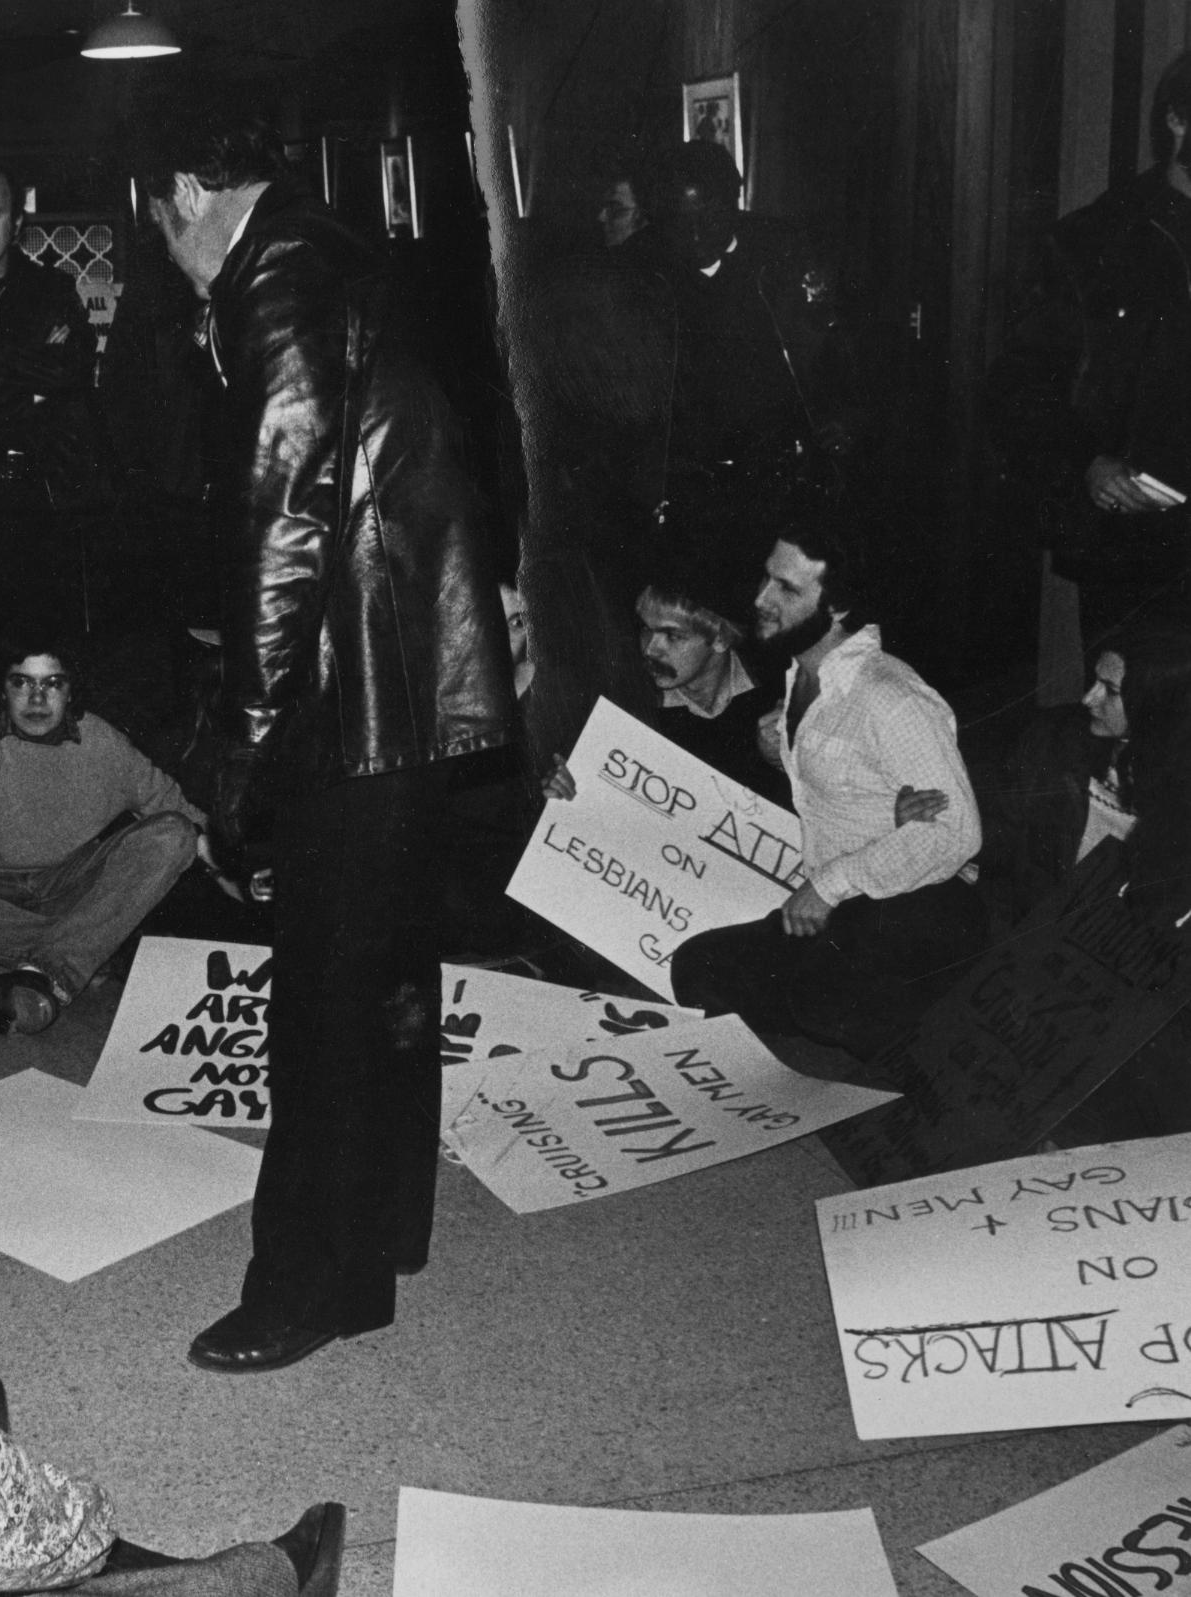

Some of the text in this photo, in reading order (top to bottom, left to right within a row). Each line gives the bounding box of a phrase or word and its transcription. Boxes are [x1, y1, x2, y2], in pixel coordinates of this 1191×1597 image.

[603, 749, 697, 817] STOP
[543, 822, 693, 932] LESBIANS
[661, 844, 706, 880] ON
[140, 1023, 269, 1058] ANG
[186, 994, 269, 1026] AR
[143, 1087, 269, 1120] GAY
[551, 1054, 717, 1164] KILLS
[664, 1049, 800, 1131] GAY MEN
[831, 1166, 1126, 1233] GAY MEN!!!
[1076, 1255, 1158, 1286] ON
[854, 1319, 1108, 1384] ATTACKS
